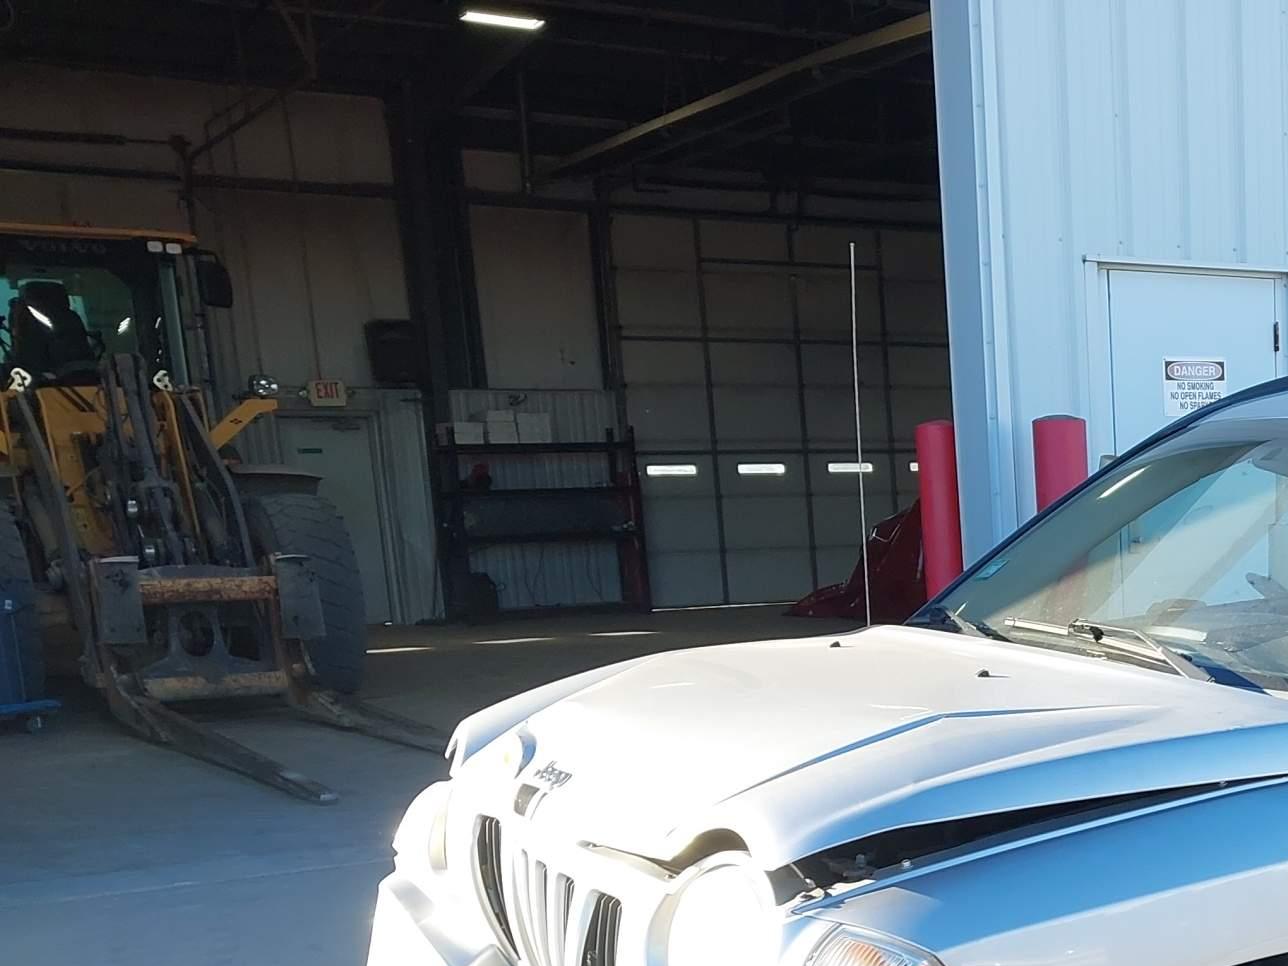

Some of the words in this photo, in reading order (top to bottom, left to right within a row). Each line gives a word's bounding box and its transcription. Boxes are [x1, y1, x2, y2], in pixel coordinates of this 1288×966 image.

[1174, 365, 1216, 376] DANGER
[315, 382, 339, 399] EXIT
[1177, 382, 1186, 390] NO
[1187, 382, 1214, 390] SMOKING
[1170, 392, 1179, 400] NO
[1181, 392, 1196, 400] OPEN
[1198, 392, 1221, 400] FLAMES
